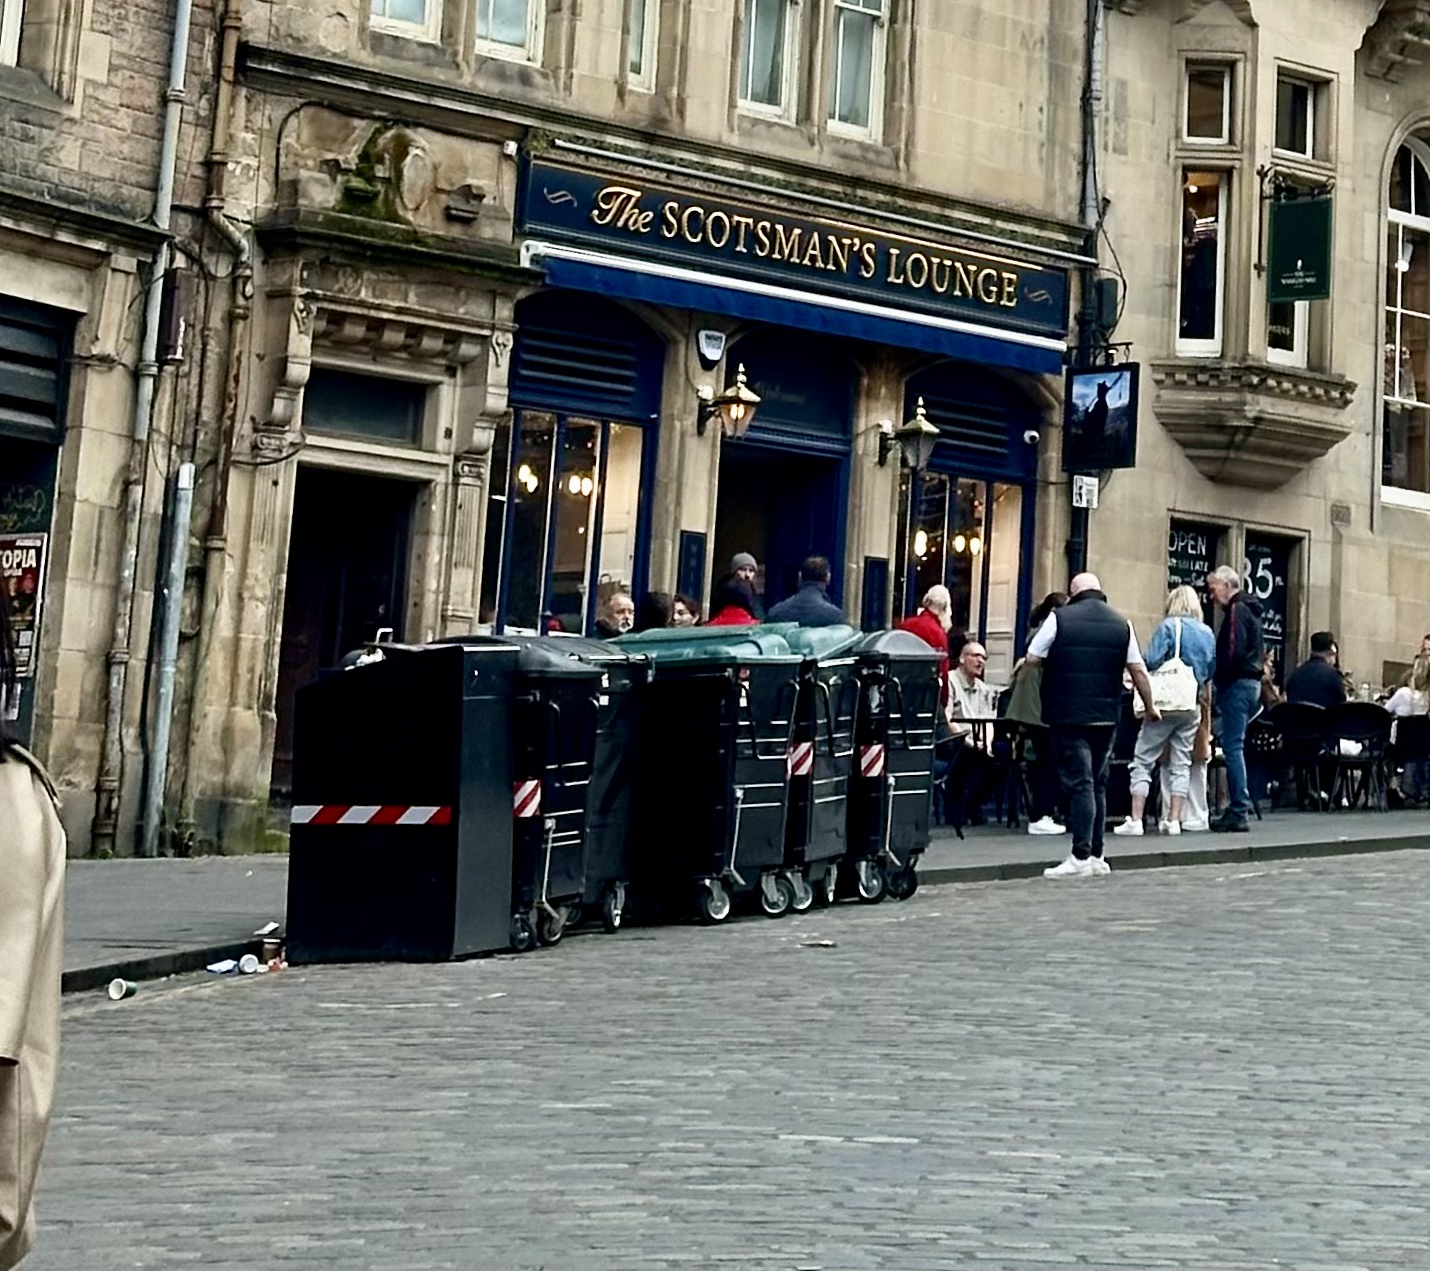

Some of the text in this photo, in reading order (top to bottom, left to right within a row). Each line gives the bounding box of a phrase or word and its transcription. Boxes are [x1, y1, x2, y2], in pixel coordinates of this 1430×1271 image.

[592, 186, 1018, 307] The SCOTSMAN'S LOUNGE
[1168, 530, 1207, 556] OPEN
[0, 549, 37, 568] OPIA
